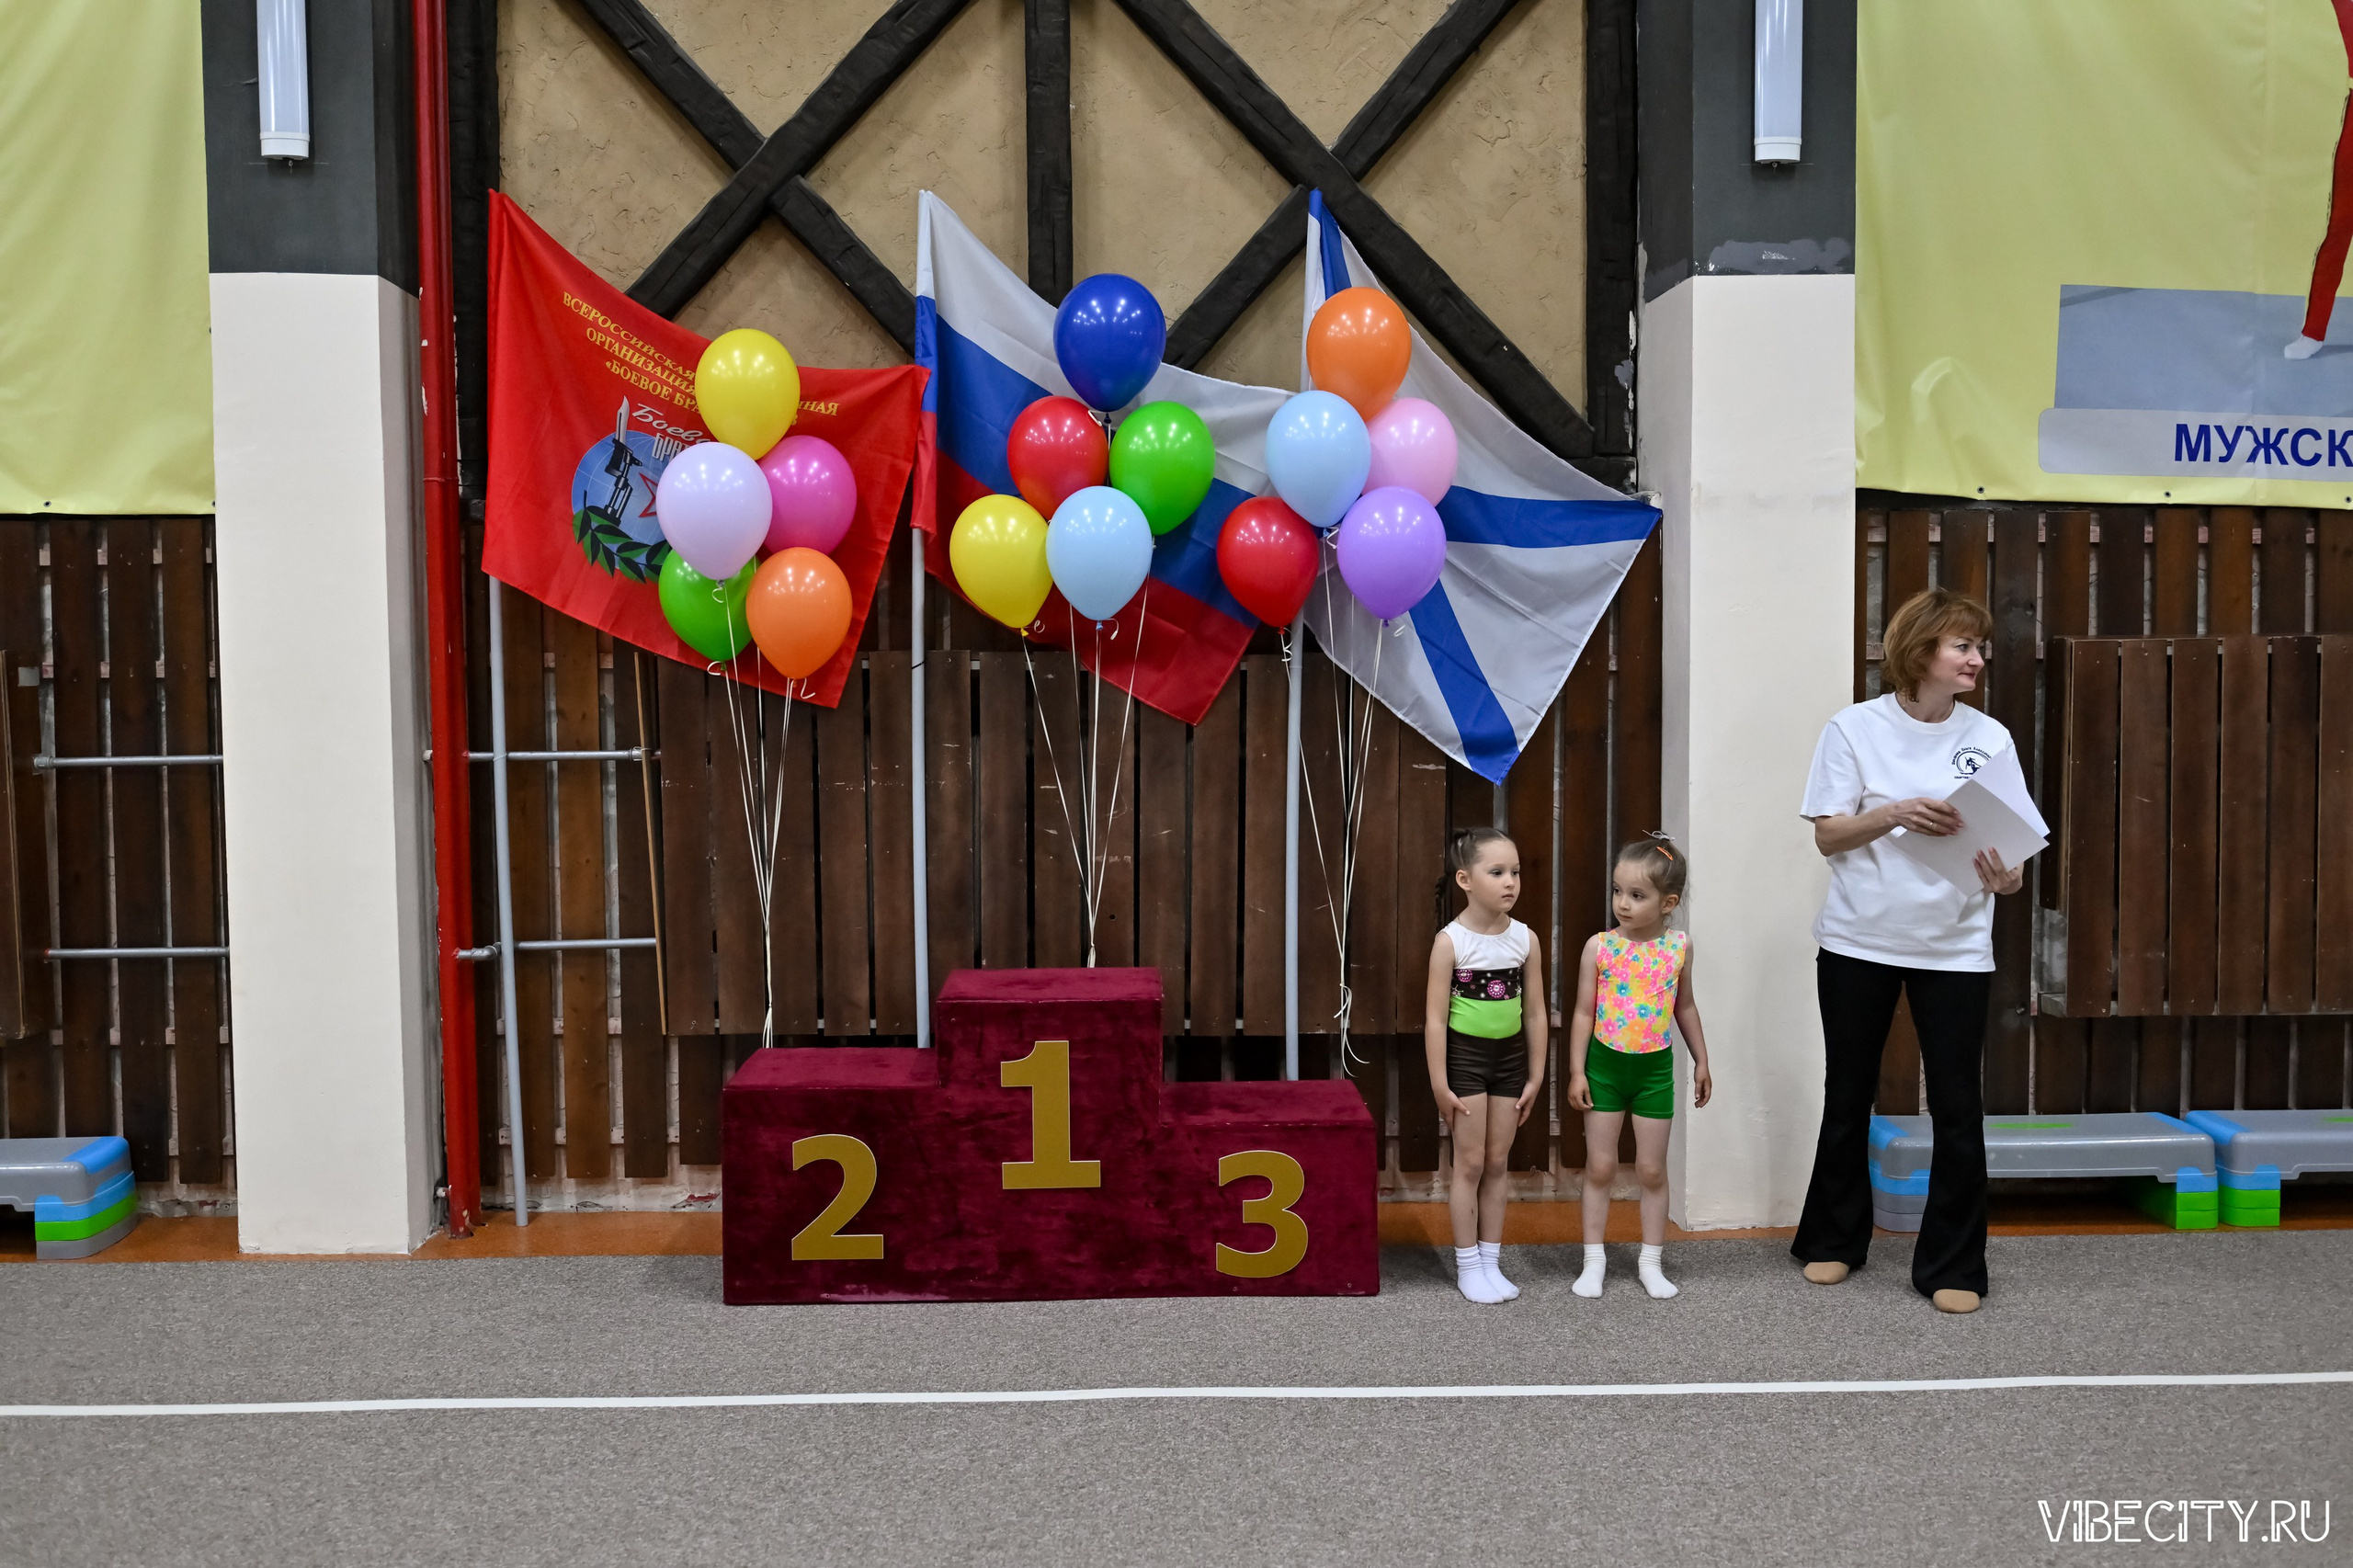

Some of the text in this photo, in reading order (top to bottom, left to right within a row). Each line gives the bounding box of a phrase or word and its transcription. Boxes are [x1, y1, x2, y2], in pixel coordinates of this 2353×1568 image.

[563, 291, 696, 381] ВСЕРОССИЙСКАЯ
[586, 327, 696, 395] ОРГАНИЗАЦИЯ
[605, 359, 673, 401] «БОЕВОЕ
[2174, 424, 2353, 467] МУЖСК
[1000, 1040, 1101, 1189] 1
[791, 1134, 883, 1260] 2
[1216, 1150, 1308, 1278] 3
